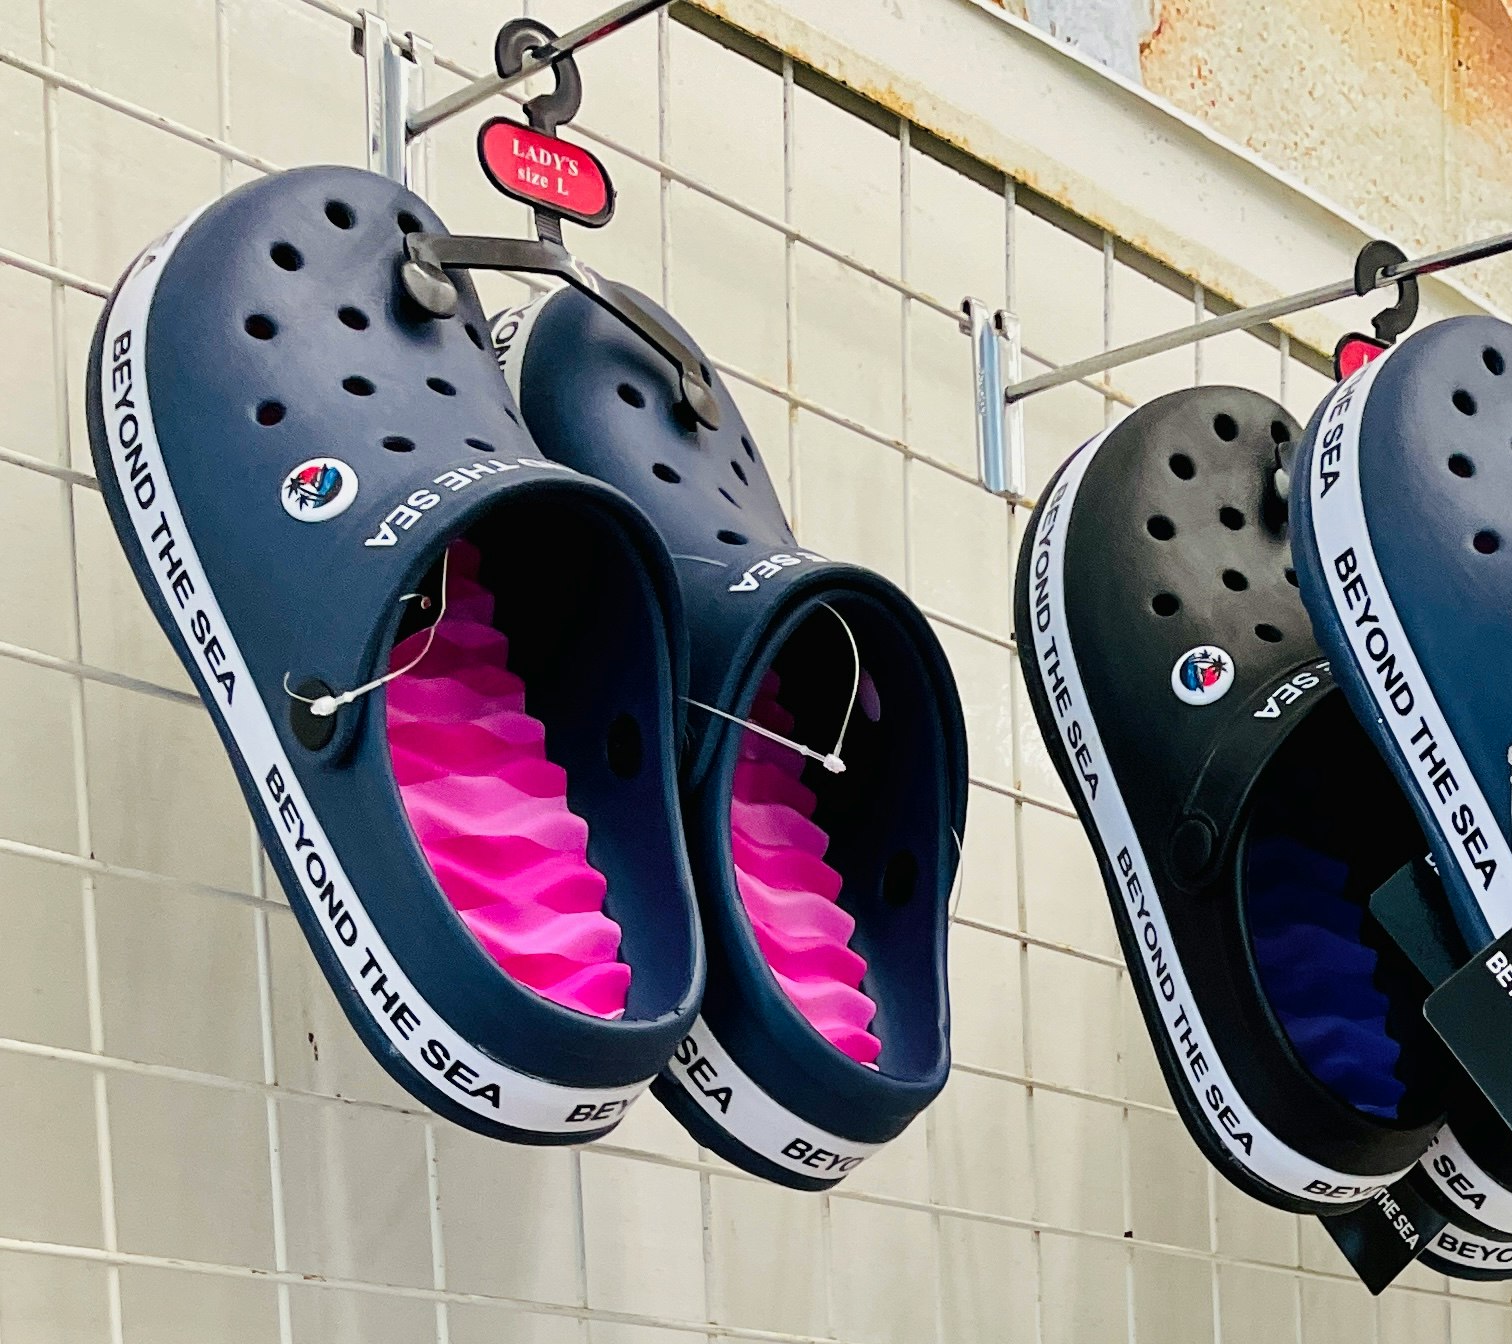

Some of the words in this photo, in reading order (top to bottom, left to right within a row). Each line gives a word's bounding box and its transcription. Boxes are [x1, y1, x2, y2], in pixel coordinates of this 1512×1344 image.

[512, 139, 580, 177] LADY'S
[517, 166, 548, 189] size
[557, 178, 569, 196] L
[434, 459, 520, 492] THE
[1319, 422, 1345, 499] SEA
[111, 329, 157, 511] BEYOND
[150, 511, 196, 609] THE
[190, 609, 237, 707] SEA
[364, 489, 441, 548] SEA
[729, 551, 807, 594] SEA
[1028, 482, 1069, 633] BEYOND
[1041, 640, 1071, 718] THE
[1254, 671, 1319, 721] SEA
[1333, 547, 1417, 716] BEYOND
[1411, 720, 1459, 803] THE
[1451, 804, 1500, 892] SEA
[1066, 722, 1101, 802] SEA
[264, 763, 358, 947] BEYOND
[359, 948, 422, 1042] THE
[420, 1040, 502, 1109] SEA
[1117, 847, 1176, 1002] BEYOND
[1171, 1004, 1209, 1082] THE
[1206, 1083, 1255, 1156] SEA
[676, 1035, 735, 1114] SEA
[566, 1100, 632, 1123] BEY
[781, 1138, 864, 1172] BEYO
[1433, 1155, 1489, 1210] SEA
[1374, 1188, 1401, 1220] THE
[1392, 1214, 1420, 1250] SEA
